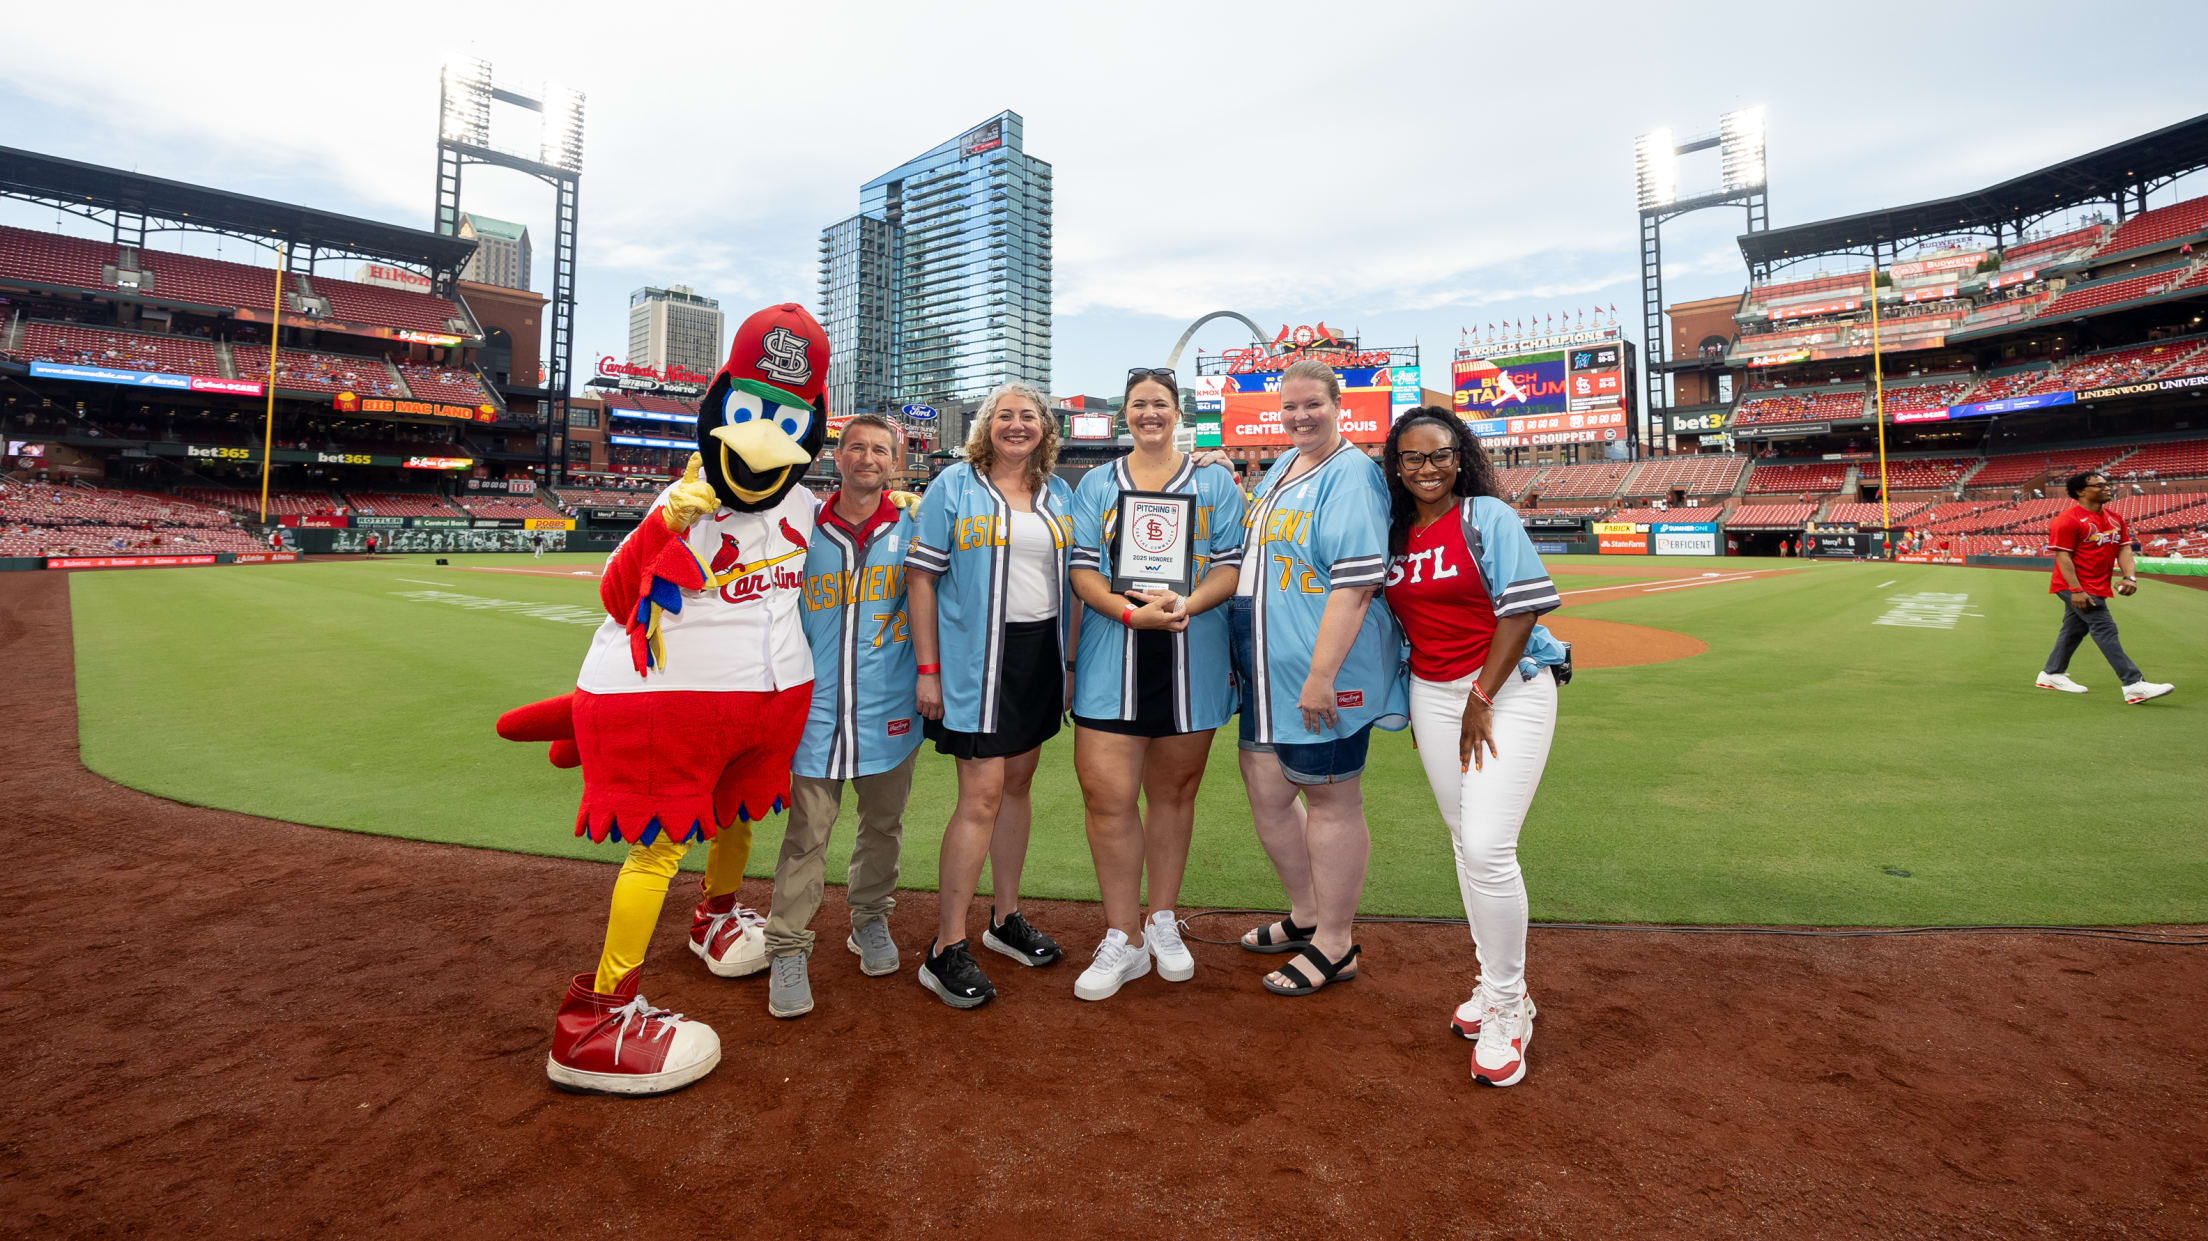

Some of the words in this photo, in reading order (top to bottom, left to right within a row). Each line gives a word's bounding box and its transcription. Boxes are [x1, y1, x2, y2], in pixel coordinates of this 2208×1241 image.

[369, 265, 430, 287] Hilton
[1469, 344, 1517, 356] WORLD
[599, 355, 659, 378] Cardinals
[658, 364, 706, 384] Nation
[663, 384, 698, 394] ROOFTOP
[2077, 383, 2158, 401] LINDENWOOD
[362, 399, 394, 412] BIG
[395, 400, 433, 415] MAC
[433, 404, 473, 420] LAND
[910, 404, 931, 417] Ford
[1480, 436, 1519, 448] BROWN
[1522, 437, 1530, 445] &
[1532, 431, 1596, 444] CROUPPEN
[187, 445, 250, 459] bet365
[318, 453, 372, 465] bet365
[1136, 504, 1170, 514] PITCHING
[424, 519, 449, 527] Central
[451, 519, 470, 527] Bank
[1273, 554, 1325, 594] 72
[872, 610, 909, 648] 72
